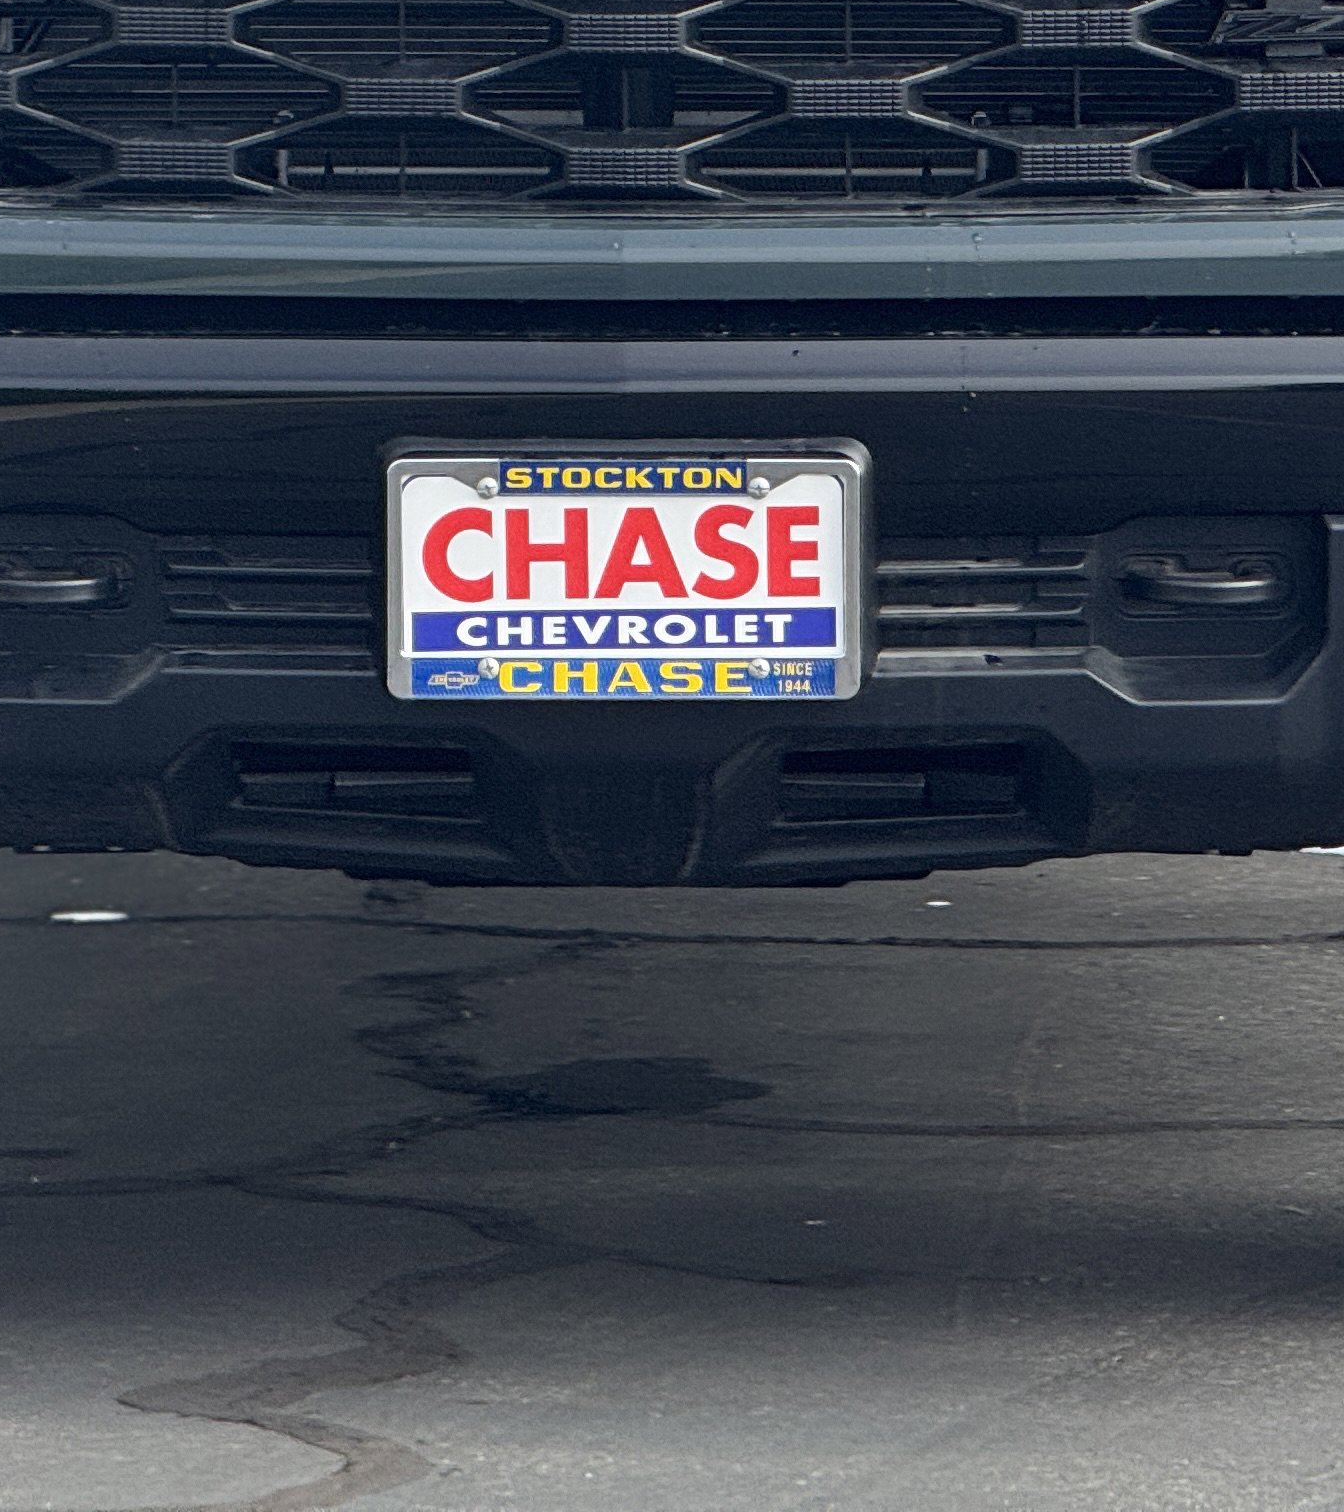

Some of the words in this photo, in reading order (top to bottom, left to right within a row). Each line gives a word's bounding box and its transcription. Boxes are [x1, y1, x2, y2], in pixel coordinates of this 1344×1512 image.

[505, 466, 743, 489] STOCKTON
[422, 504, 821, 603] CHASE
[456, 614, 793, 647] CHEVROLET
[499, 661, 753, 694] CHASE
[773, 662, 813, 677] SINCE
[777, 679, 812, 693] 1944
